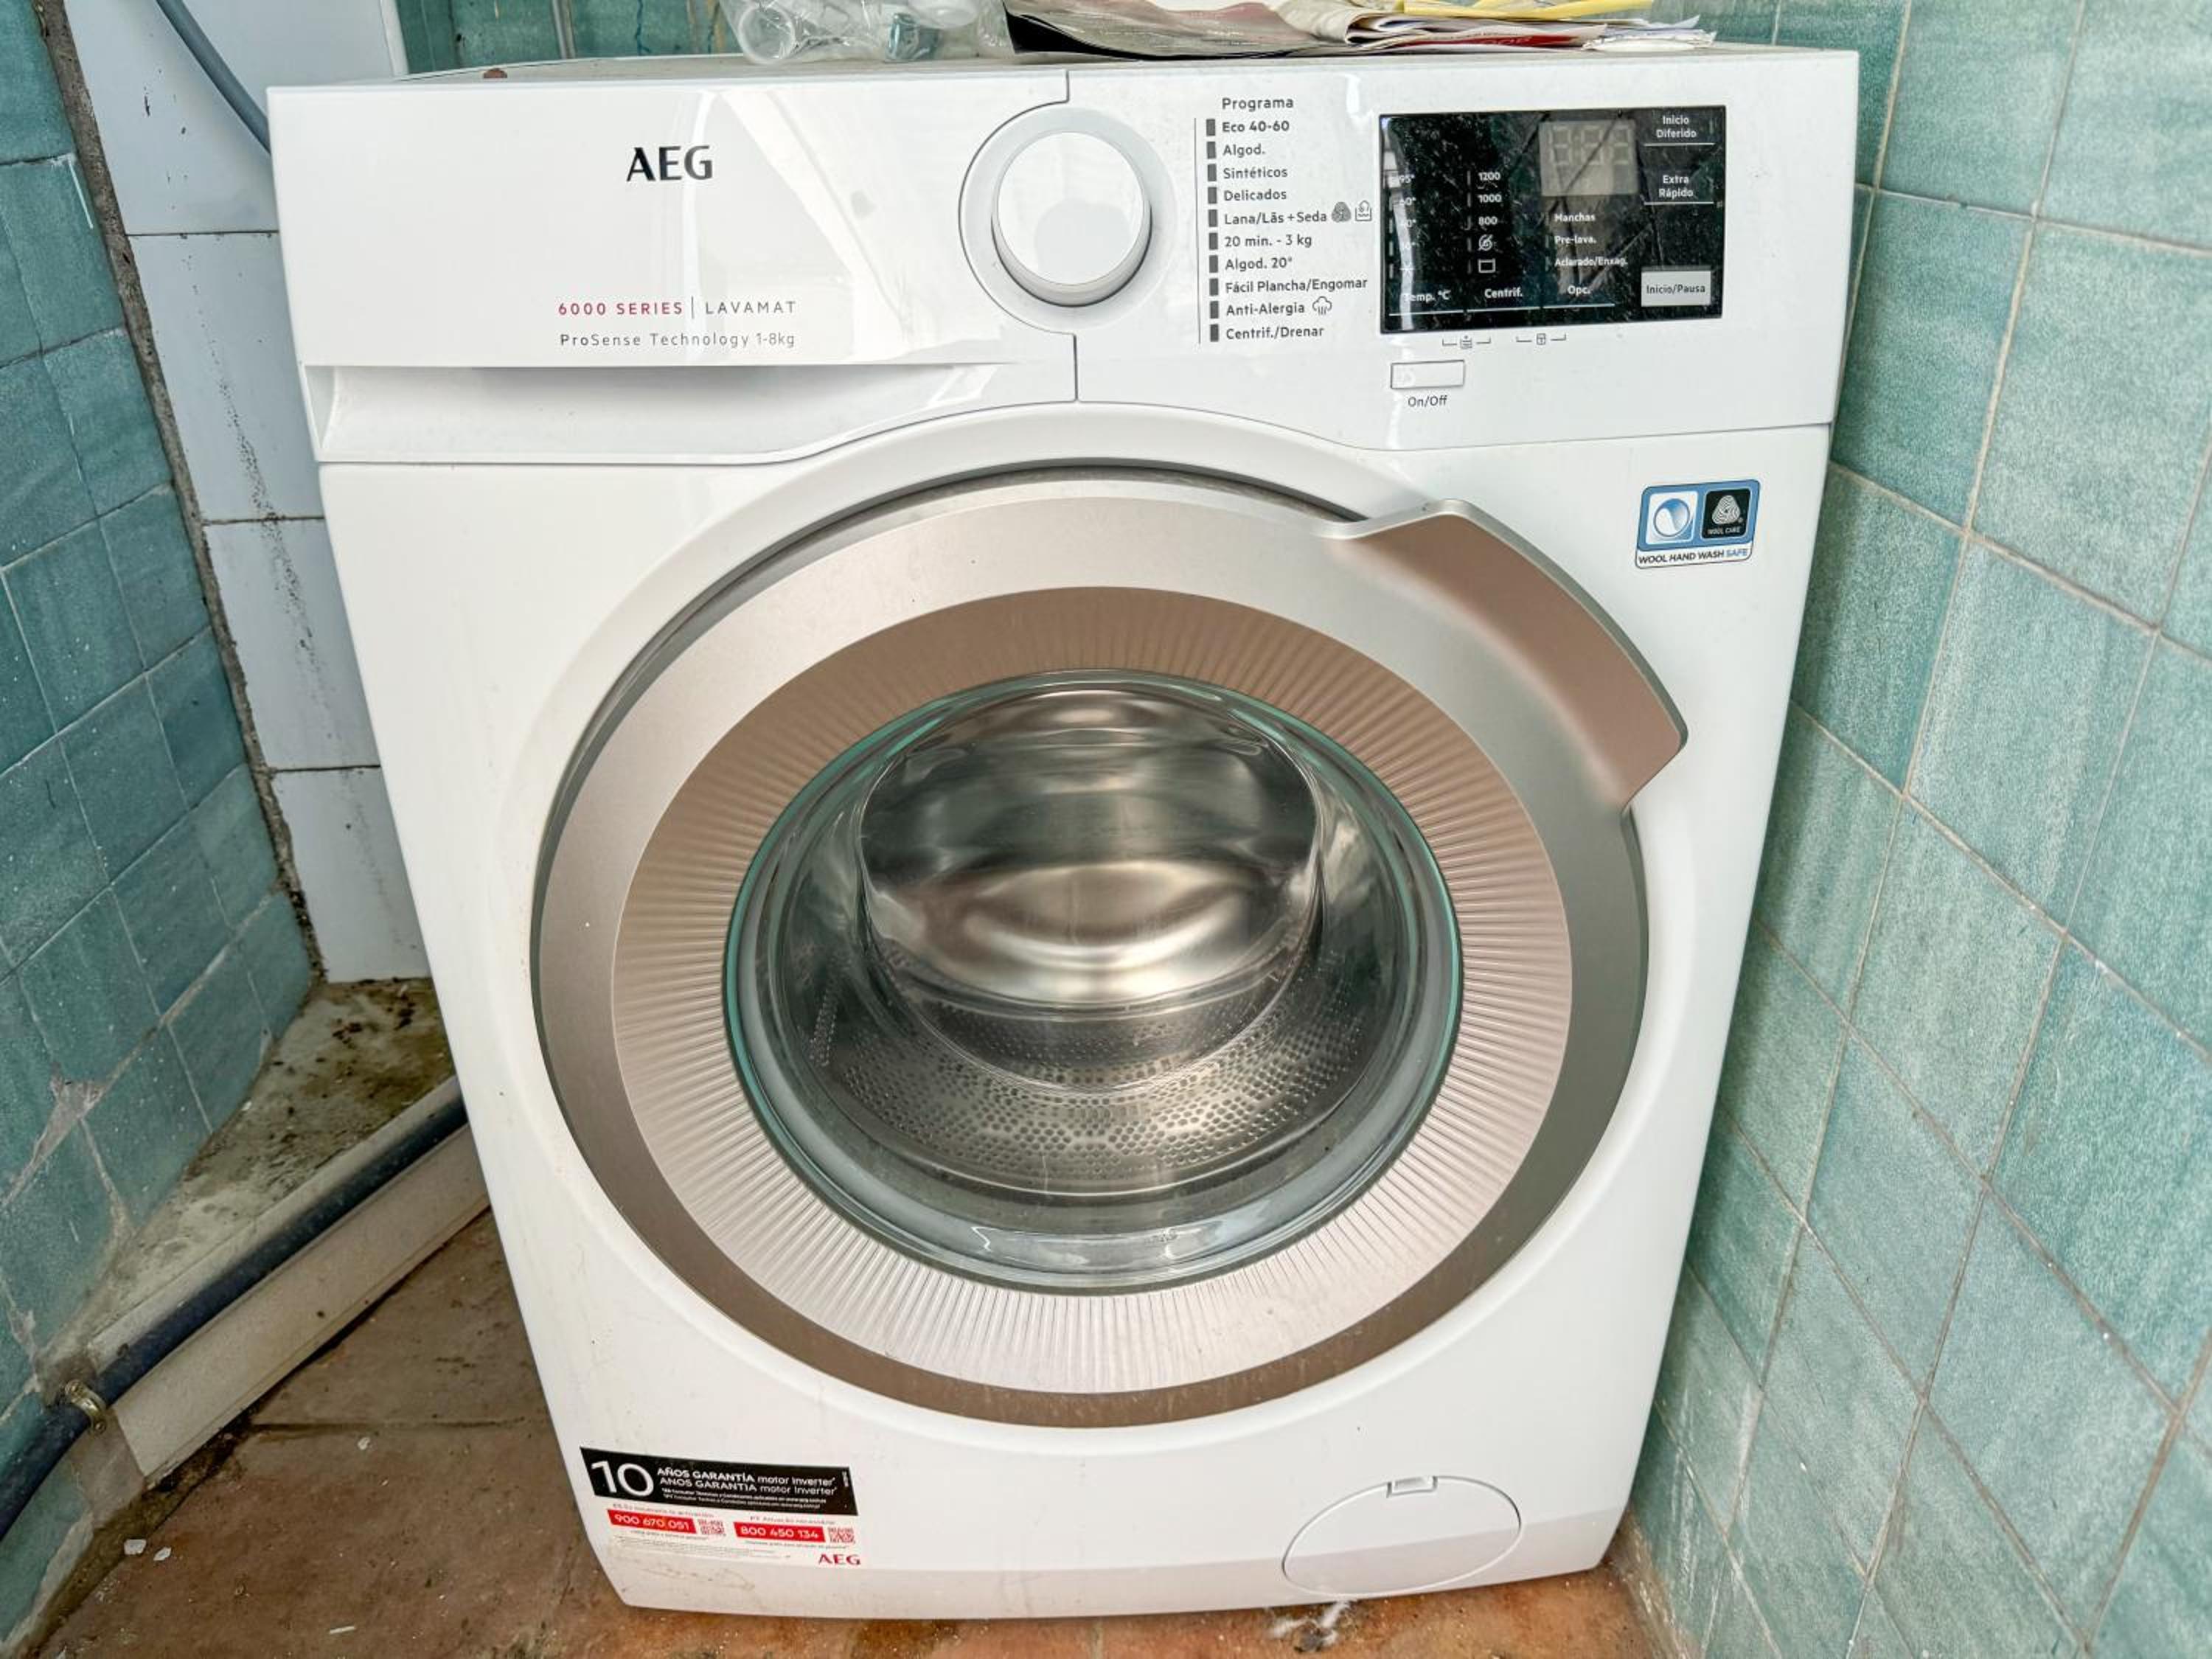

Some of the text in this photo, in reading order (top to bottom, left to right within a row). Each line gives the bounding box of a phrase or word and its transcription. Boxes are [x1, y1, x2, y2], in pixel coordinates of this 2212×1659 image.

[1221, 97, 1294, 112] Programa
[1221, 119, 1290, 133] Eco 40-60
[1662, 114, 1690, 125] Inicio
[1655, 128, 1697, 139] Diferido
[1222, 143, 1266, 158] Algod.
[626, 145, 714, 182] AEG
[1222, 166, 1288, 179] Sintéticos
[1478, 171, 1501, 181] 1200
[1662, 175, 1690, 184] Extra
[1223, 188, 1287, 201] Delicados
[1478, 193, 1503, 204] 1000
[1658, 187, 1694, 200] Rápido
[1224, 212, 1284, 226] Lana/Lãs
[1478, 215, 1498, 226] 800
[1554, 212, 1596, 222] Manchas
[1224, 236, 1240, 247] 20
[1245, 234, 1273, 246] min.
[1285, 234, 1293, 246] 3
[1296, 233, 1312, 248] kg
[1554, 234, 1597, 245] Pre-lava.
[1224, 258, 1267, 272] Algod.
[1225, 276, 1368, 294] Fácil Plancha/Engomar
[1567, 285, 1592, 297] Opc.
[1646, 284, 1706, 296] Inicio/Pausa
[1484, 286, 1523, 299] Centrif.
[557, 300, 797, 316] 6000 SERIES LAVAMAT
[1225, 302, 1305, 316] Anti-Alergia
[560, 332, 796, 348] ProSense Technology 1-8kg
[1225, 326, 1324, 341] Centrif./Drenar
[1407, 394, 1448, 408] On/Off
[1638, 548, 1748, 565] WOOL HAND WASH SAFE
[591, 1460, 655, 1498] 10
[657, 1467, 690, 1478] AÑOS
[692, 1470, 756, 1484] GARANTÍA
[757, 1475, 790, 1485] motor
[660, 1477, 692, 1487] ANOS
[760, 1485, 792, 1495] motor
[614, 1514, 640, 1526] 900
[740, 1526, 767, 1536] 800
[818, 1553, 861, 1565] AEG
